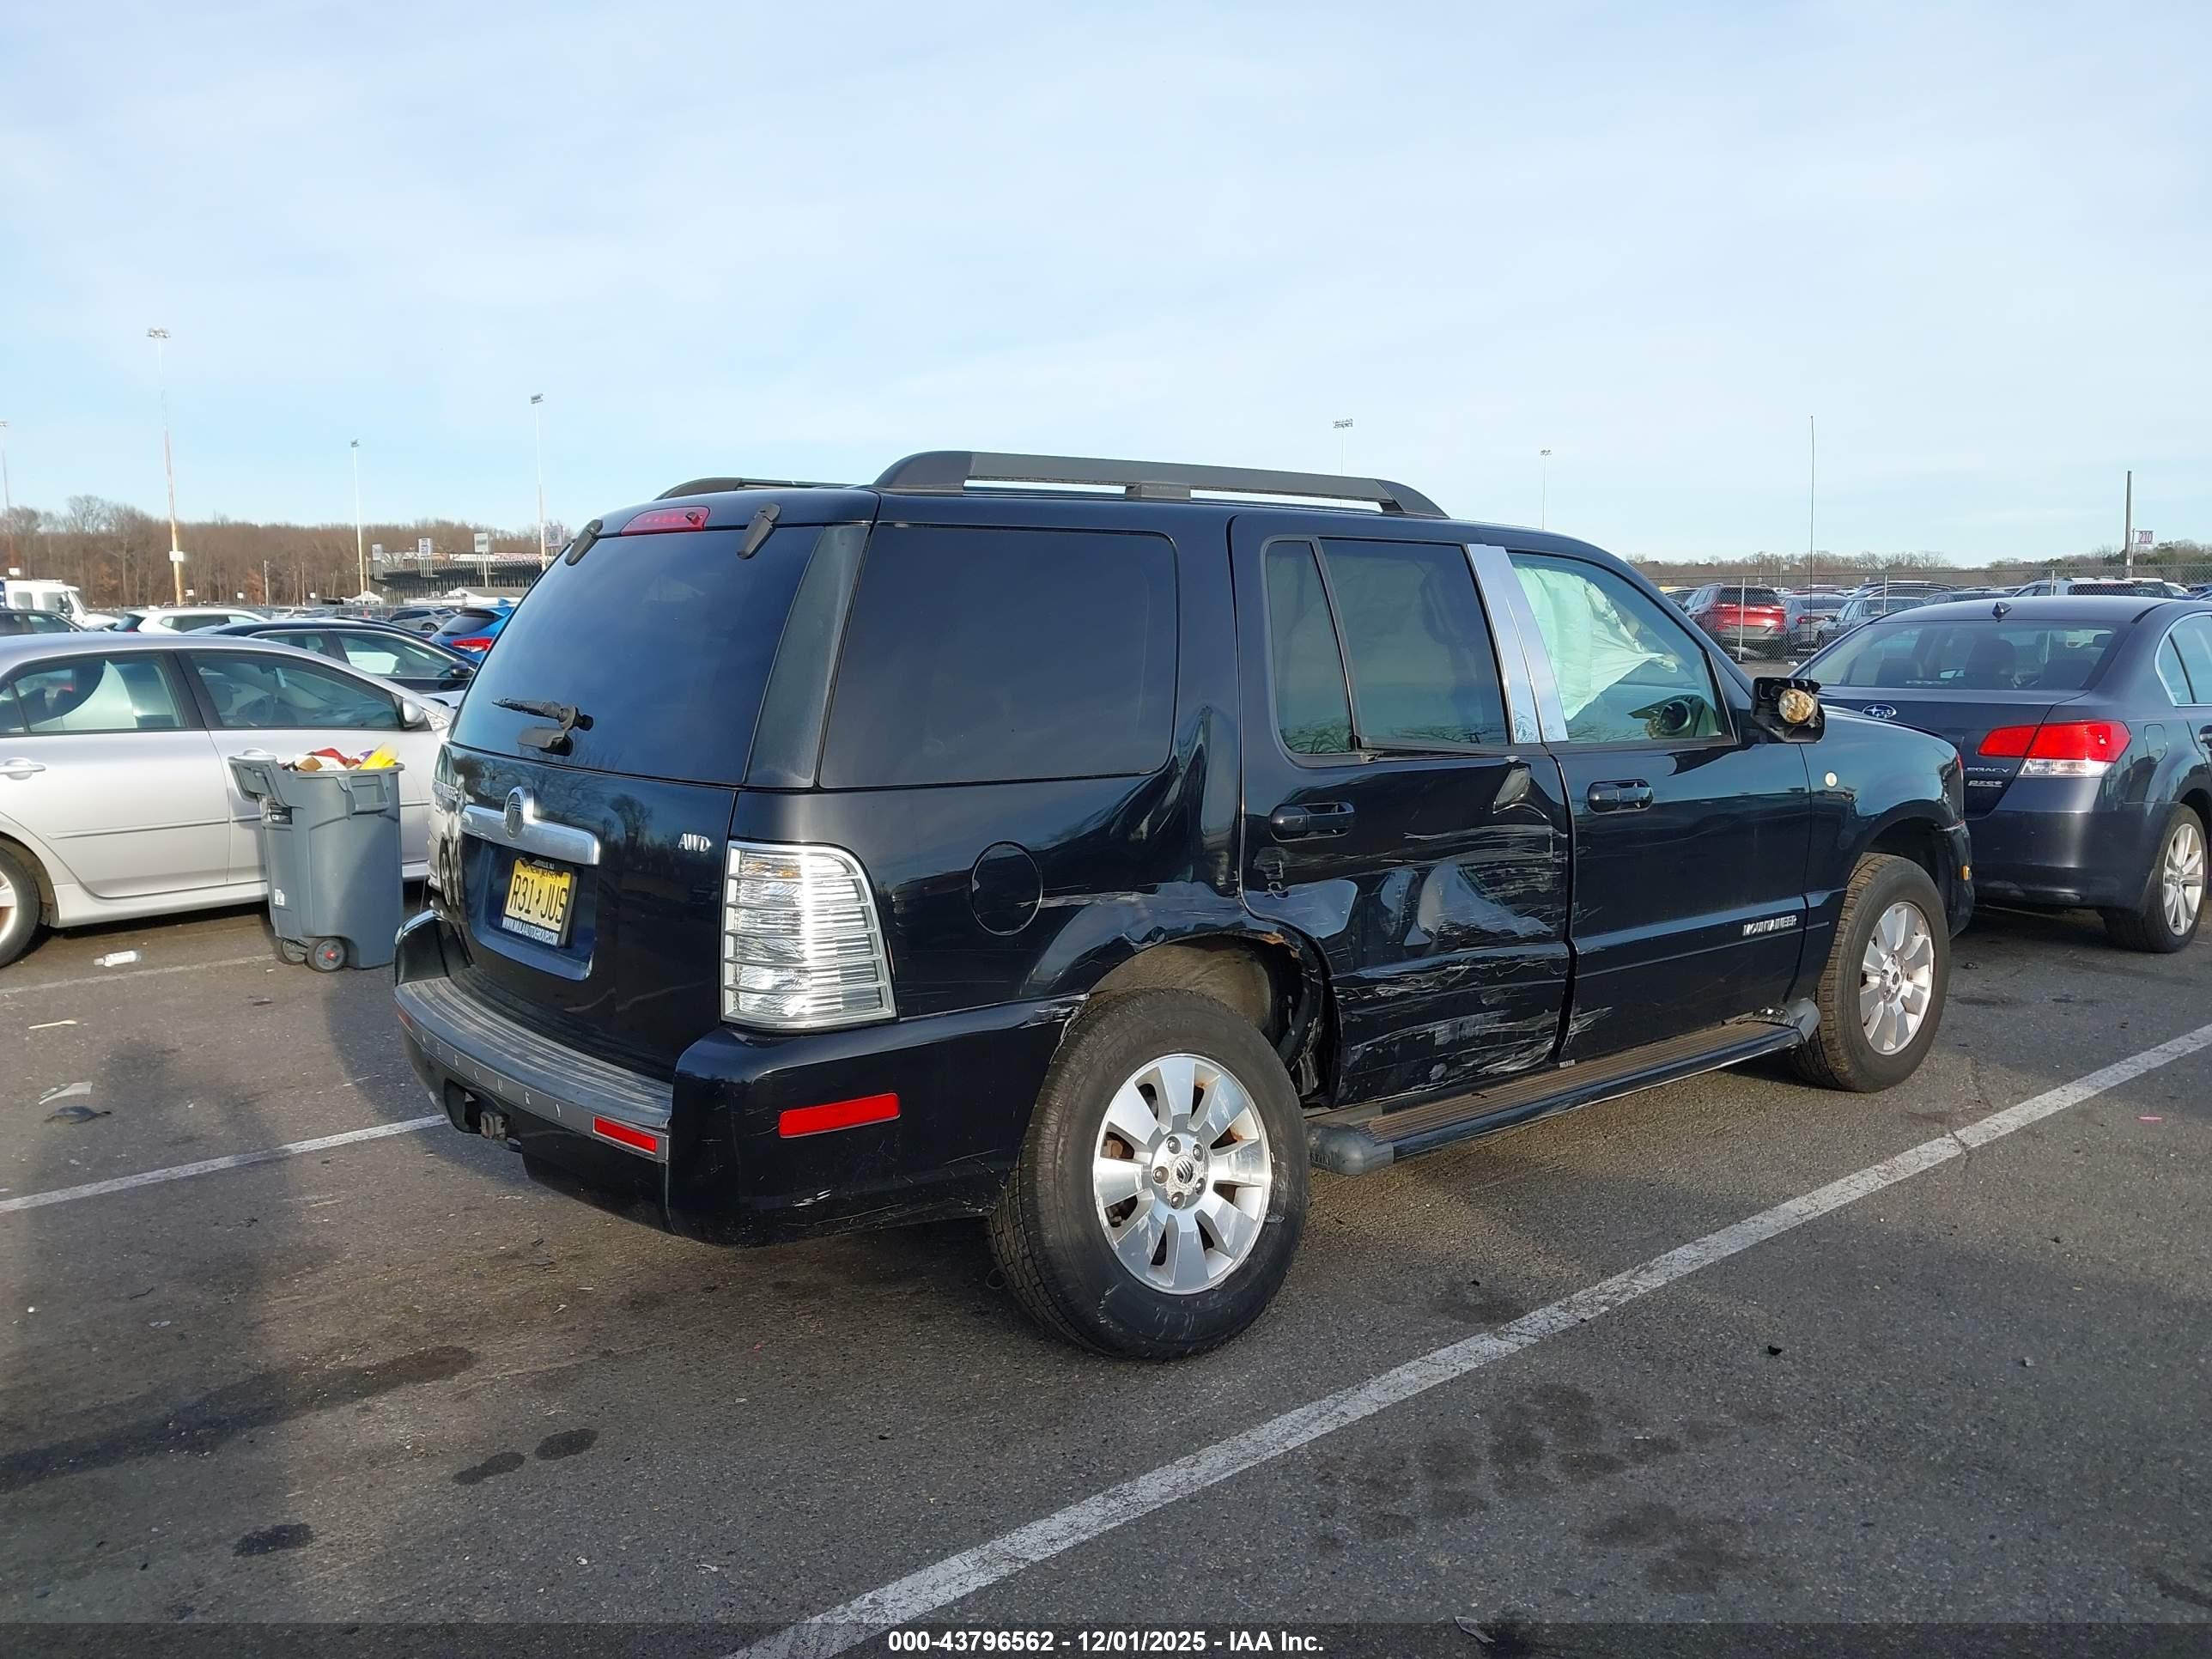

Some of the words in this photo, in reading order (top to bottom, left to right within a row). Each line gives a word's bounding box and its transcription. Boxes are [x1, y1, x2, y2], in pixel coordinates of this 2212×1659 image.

[2138, 532, 2154, 544] 210
[678, 833, 712, 852] AWD
[510, 874, 534, 914] R31
[540, 884, 568, 924] JUS
[1742, 915, 1797, 936] MOUNTAINEER
